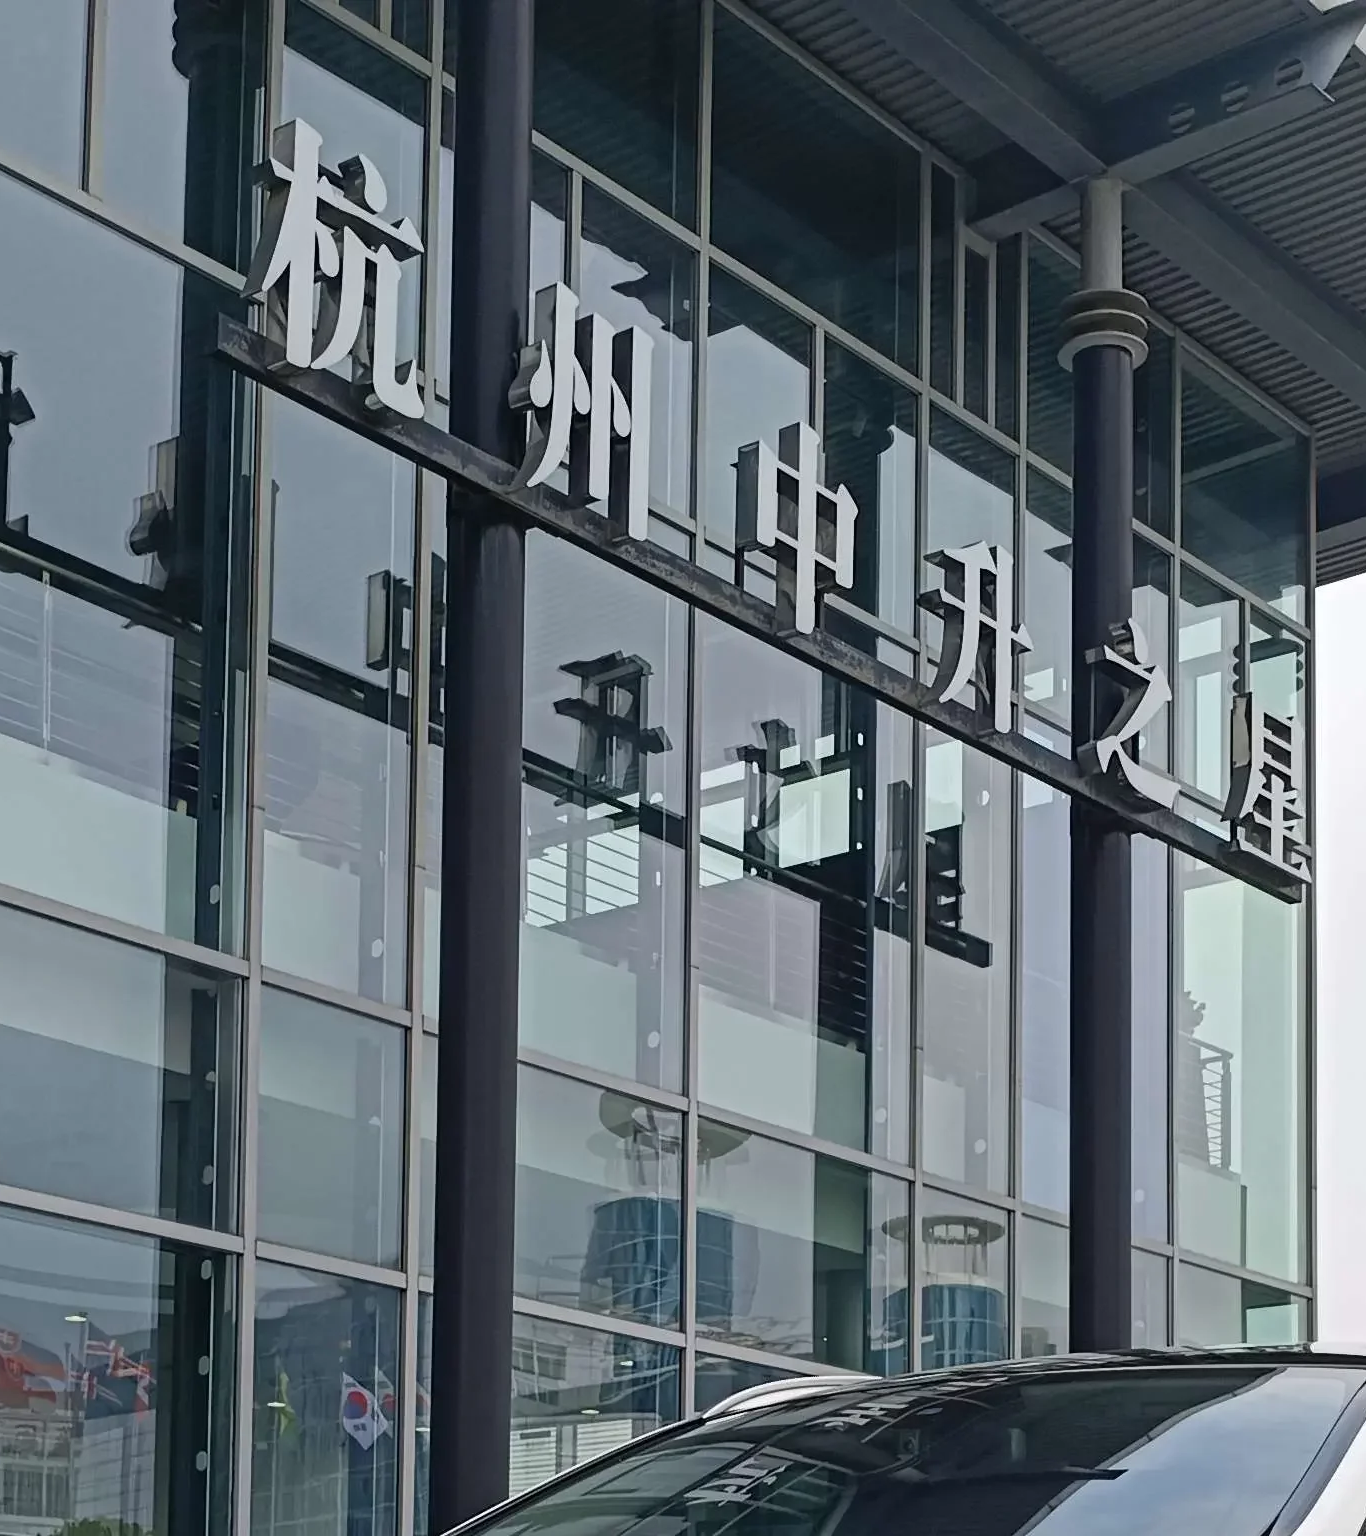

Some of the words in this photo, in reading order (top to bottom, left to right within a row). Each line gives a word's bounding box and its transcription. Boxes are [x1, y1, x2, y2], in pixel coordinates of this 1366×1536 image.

[251, 117, 1313, 884] 杭州中升之星
